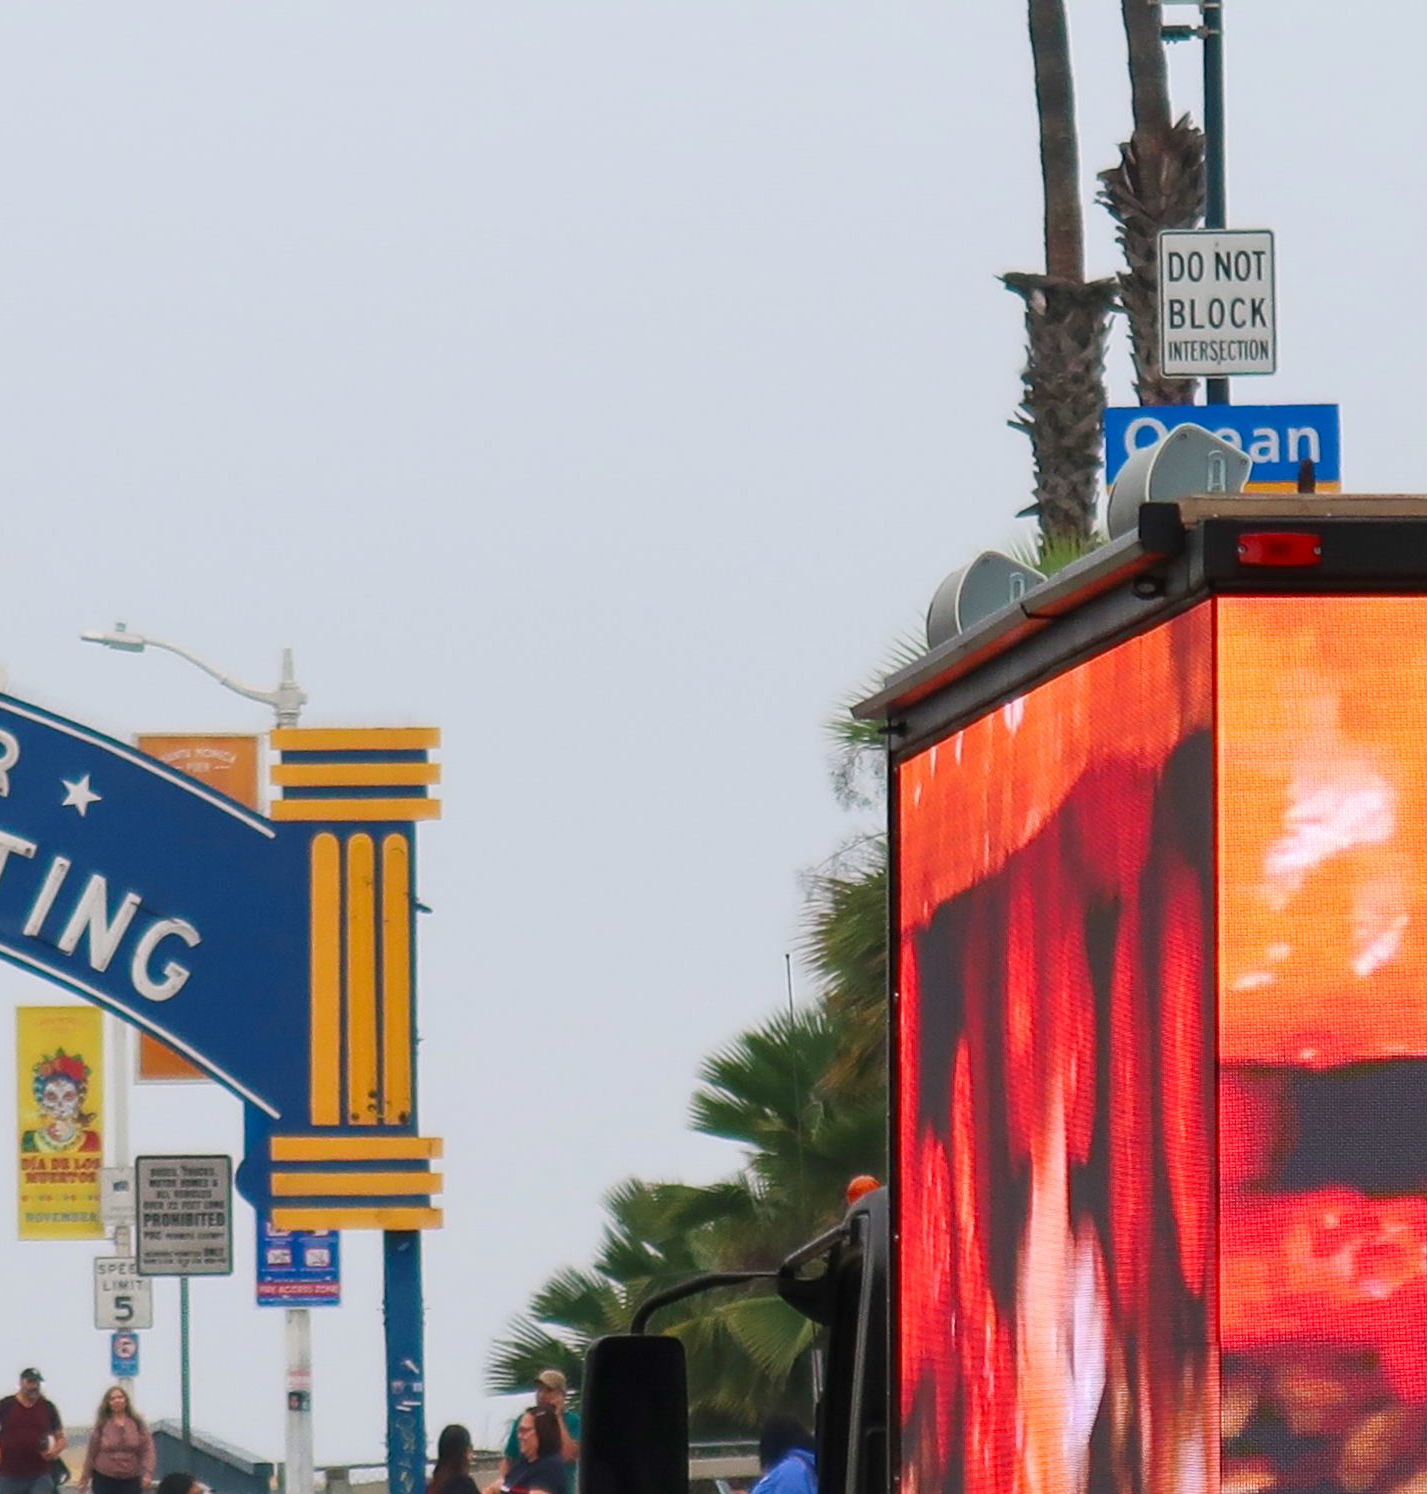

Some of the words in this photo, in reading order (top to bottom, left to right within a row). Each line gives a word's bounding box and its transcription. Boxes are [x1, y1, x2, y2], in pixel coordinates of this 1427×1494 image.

[1168, 251, 1204, 283] DO
[1214, 250, 1266, 282] NOT
[1168, 297, 1268, 329] BLOCK
[1168, 339, 1270, 362] INTERSECTION
[1124, 416, 1321, 464] Oan
[143, 1212, 225, 1228] PROHIBITED
[97, 1263, 137, 1275] SPEE
[103, 1279, 144, 1291] LIMIT
[113, 1295, 134, 1322] 5
